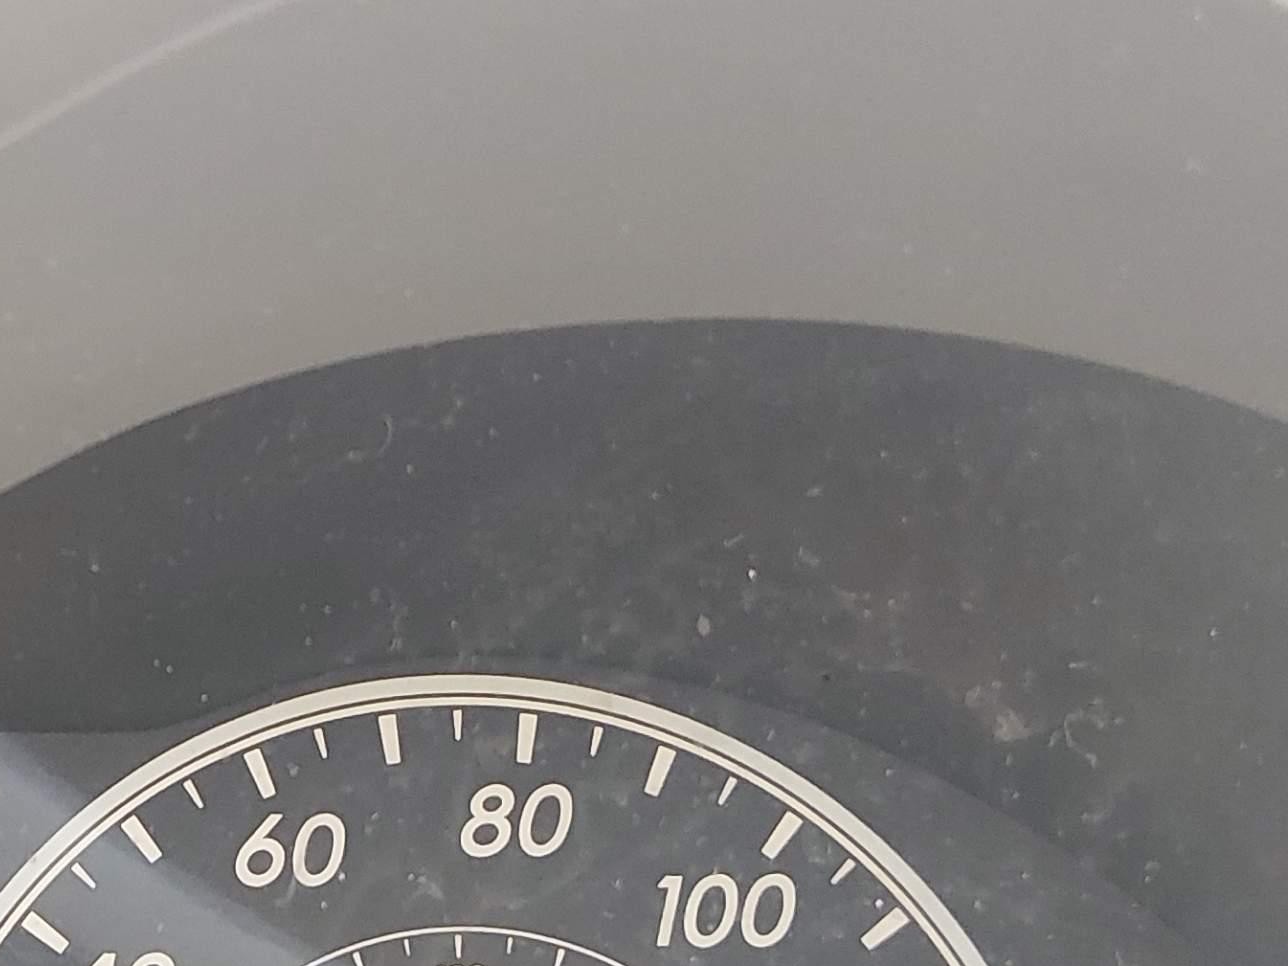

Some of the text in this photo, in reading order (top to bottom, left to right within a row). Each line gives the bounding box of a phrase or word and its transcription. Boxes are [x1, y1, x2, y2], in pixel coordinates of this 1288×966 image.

[236, 813, 345, 887] 60
[461, 784, 572, 857] 80
[657, 872, 795, 948] 100
